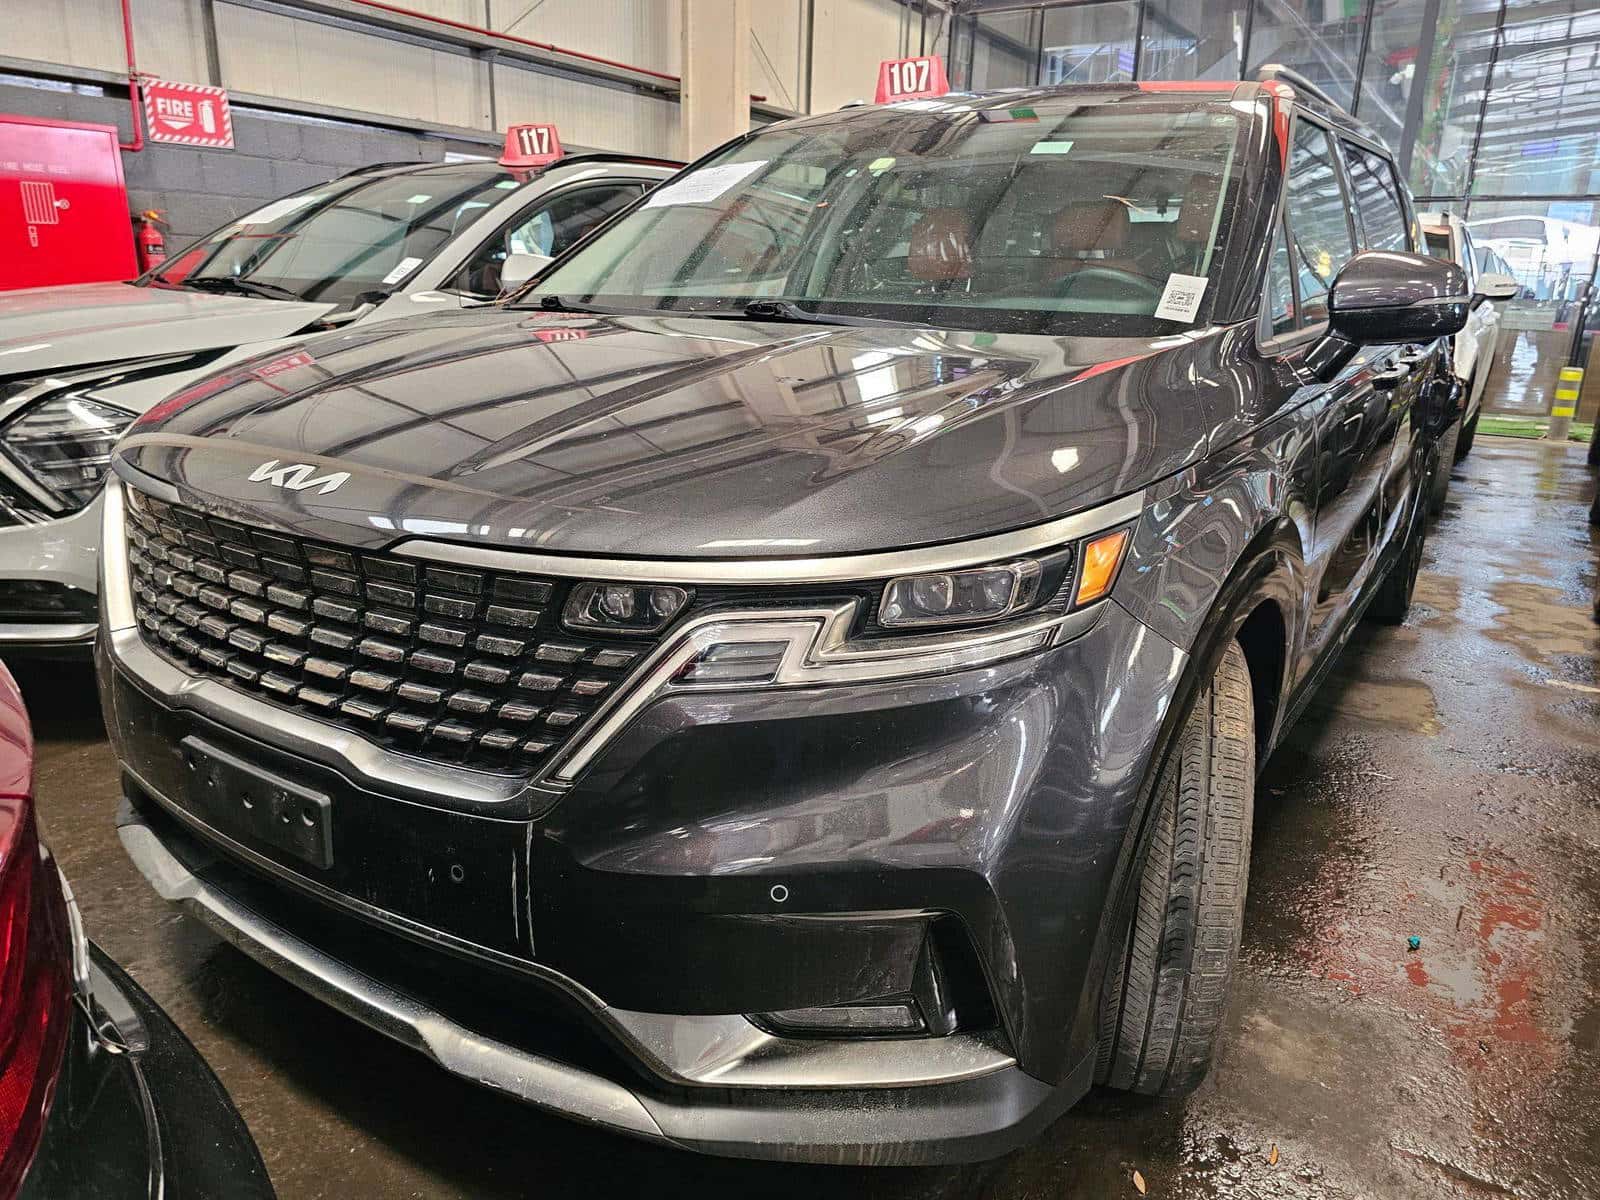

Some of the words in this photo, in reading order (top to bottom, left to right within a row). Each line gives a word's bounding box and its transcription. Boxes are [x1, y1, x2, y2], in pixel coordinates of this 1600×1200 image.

[890, 60, 930, 95] 107
[156, 97, 194, 118] FIRE
[520, 127, 550, 155] 117
[247, 459, 352, 495] KIA
